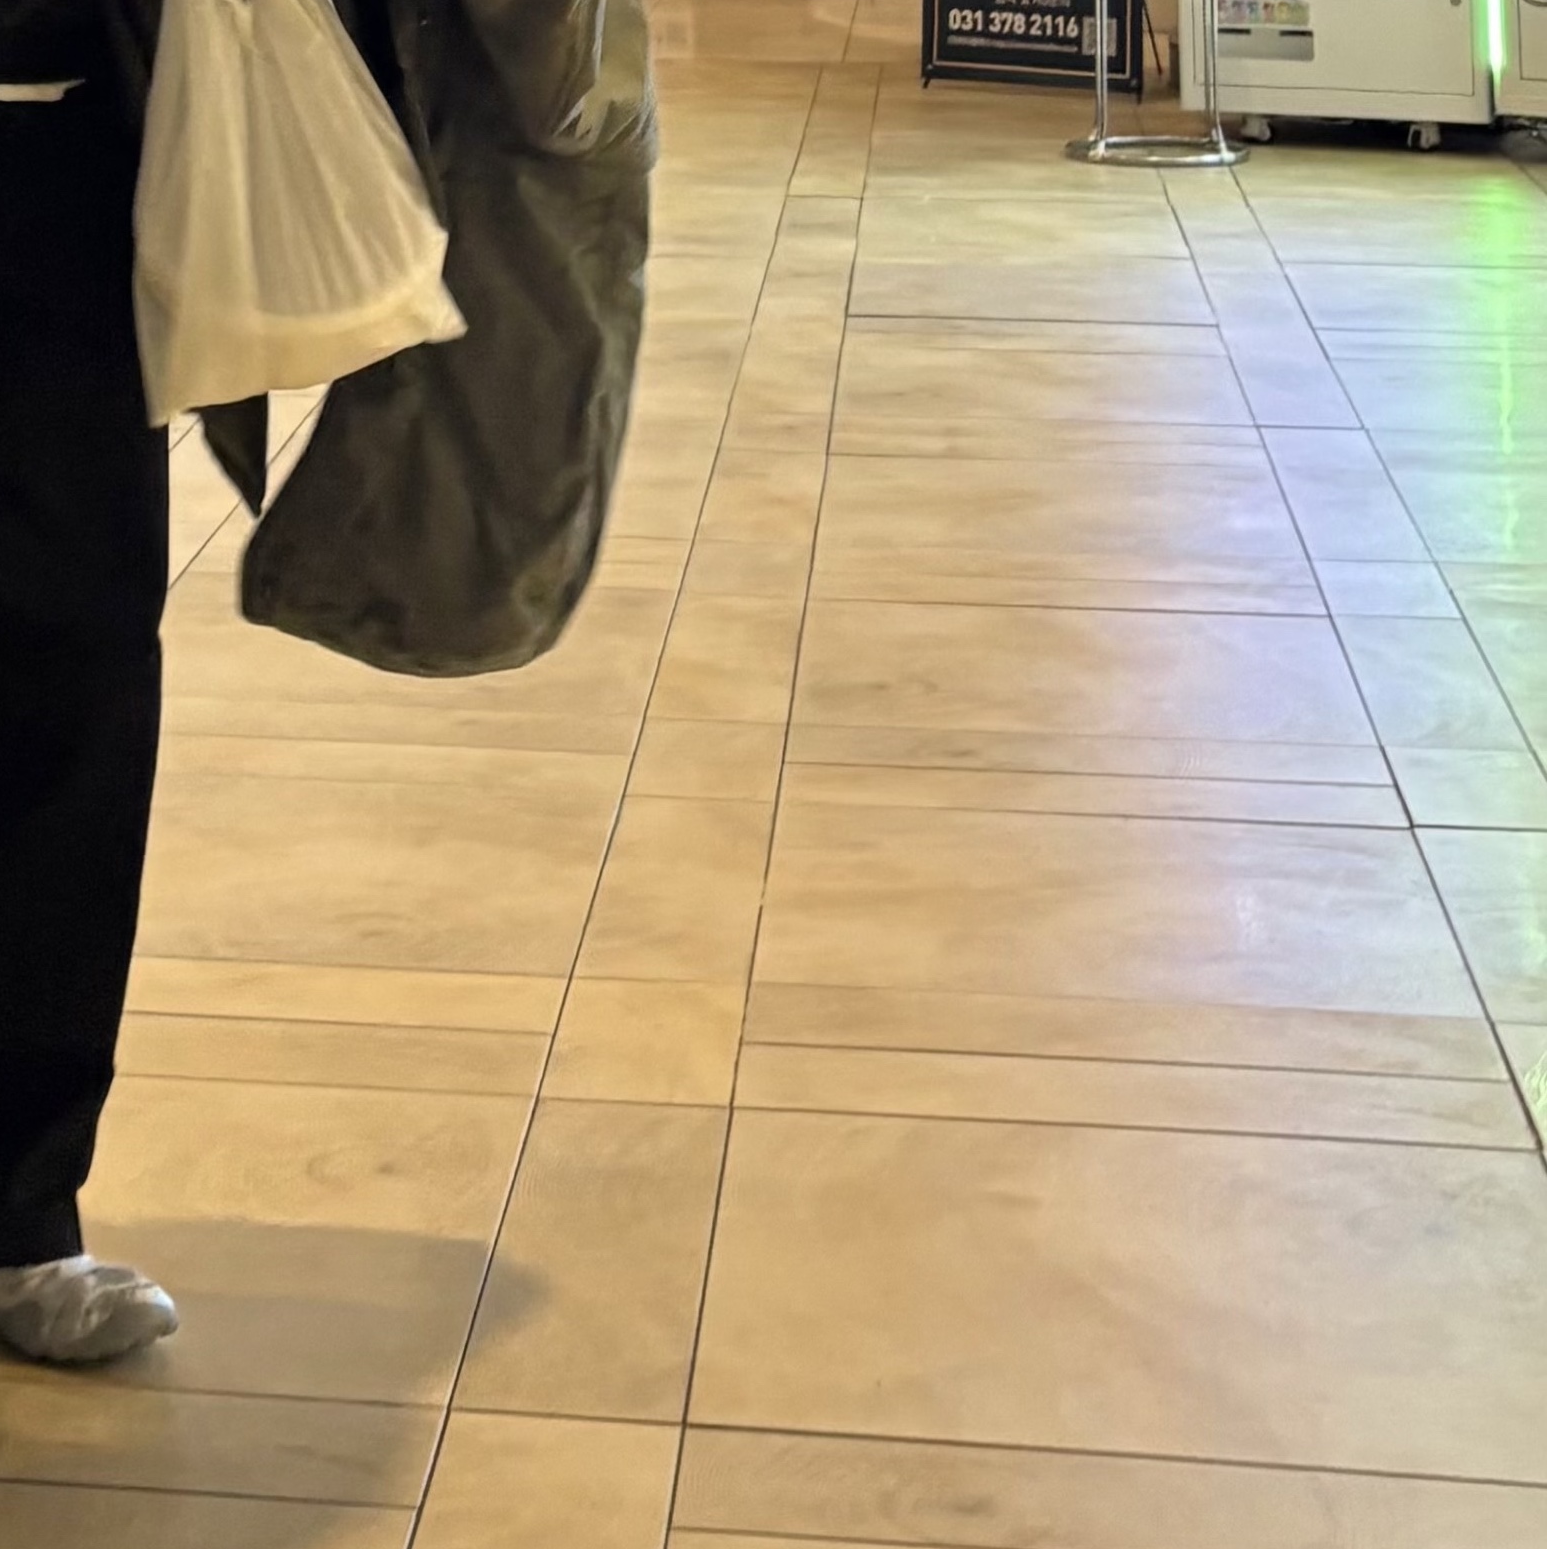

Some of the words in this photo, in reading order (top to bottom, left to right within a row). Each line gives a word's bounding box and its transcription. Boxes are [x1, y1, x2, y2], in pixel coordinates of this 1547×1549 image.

[948, 8, 983, 32] 031
[989, 11, 1026, 35] 378
[1029, 13, 1079, 38] 2116
